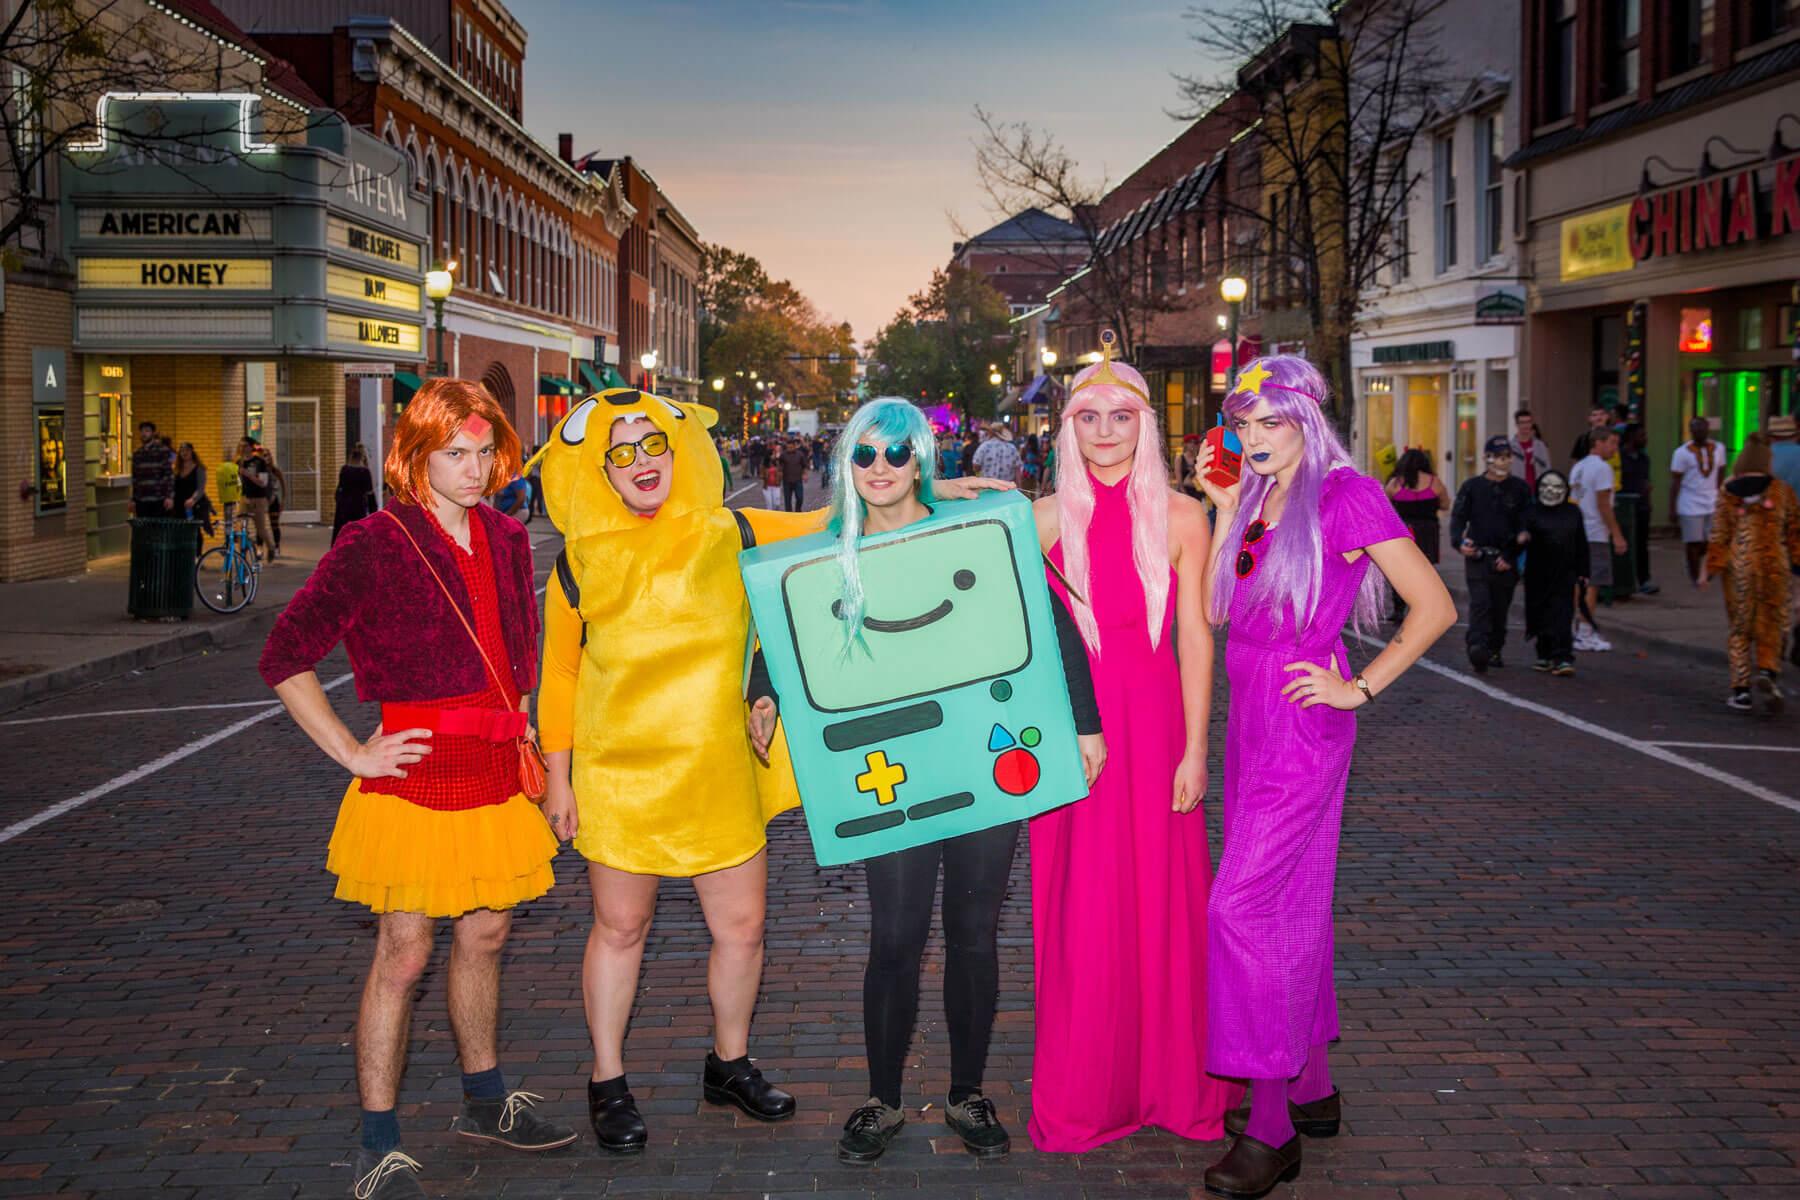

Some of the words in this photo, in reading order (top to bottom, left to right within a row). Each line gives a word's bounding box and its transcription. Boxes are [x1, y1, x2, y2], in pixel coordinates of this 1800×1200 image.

[346, 161, 407, 221] ATHENA
[99, 212, 241, 235] AMERICAN
[1628, 169, 1756, 260] CHINA
[141, 264, 227, 285] HONEY
[45, 364, 57, 387] A
